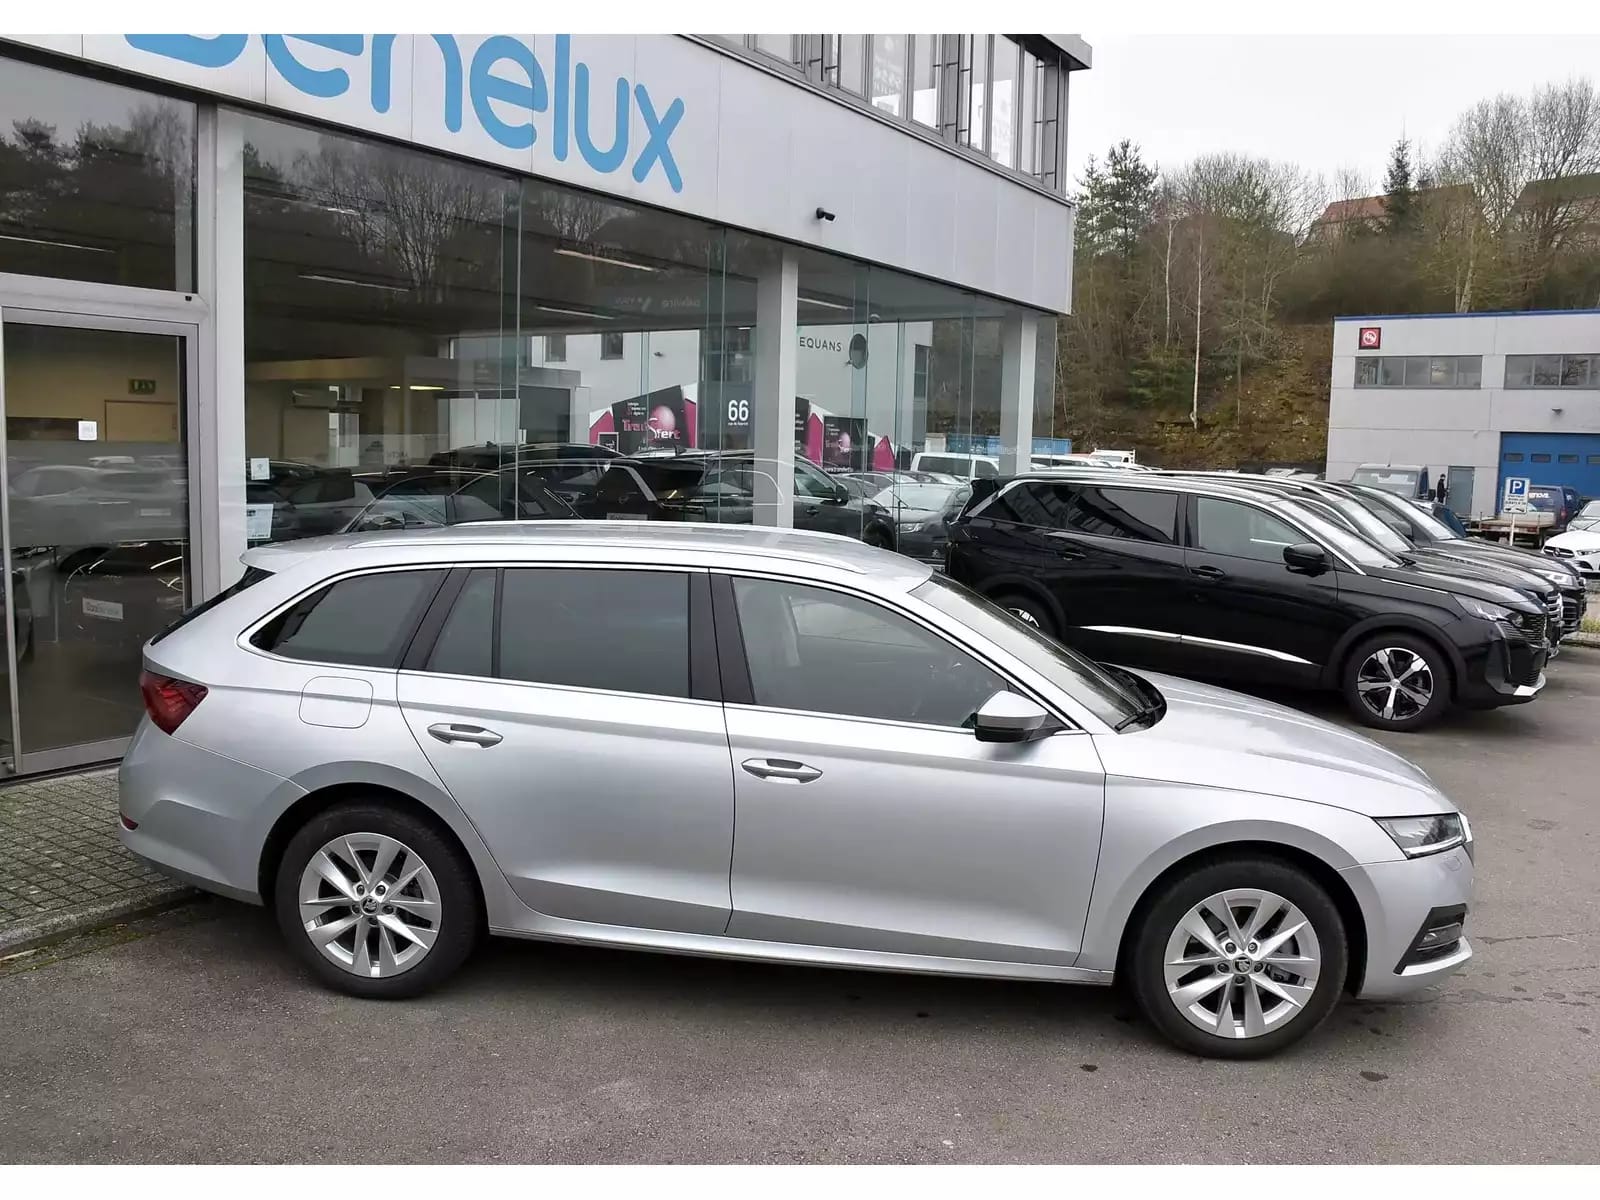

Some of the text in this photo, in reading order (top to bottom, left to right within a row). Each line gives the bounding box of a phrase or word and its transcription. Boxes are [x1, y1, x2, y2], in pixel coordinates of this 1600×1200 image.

[799, 336, 842, 352] EQUANS
[728, 399, 749, 421] 66
[1512, 481, 1522, 493] P
